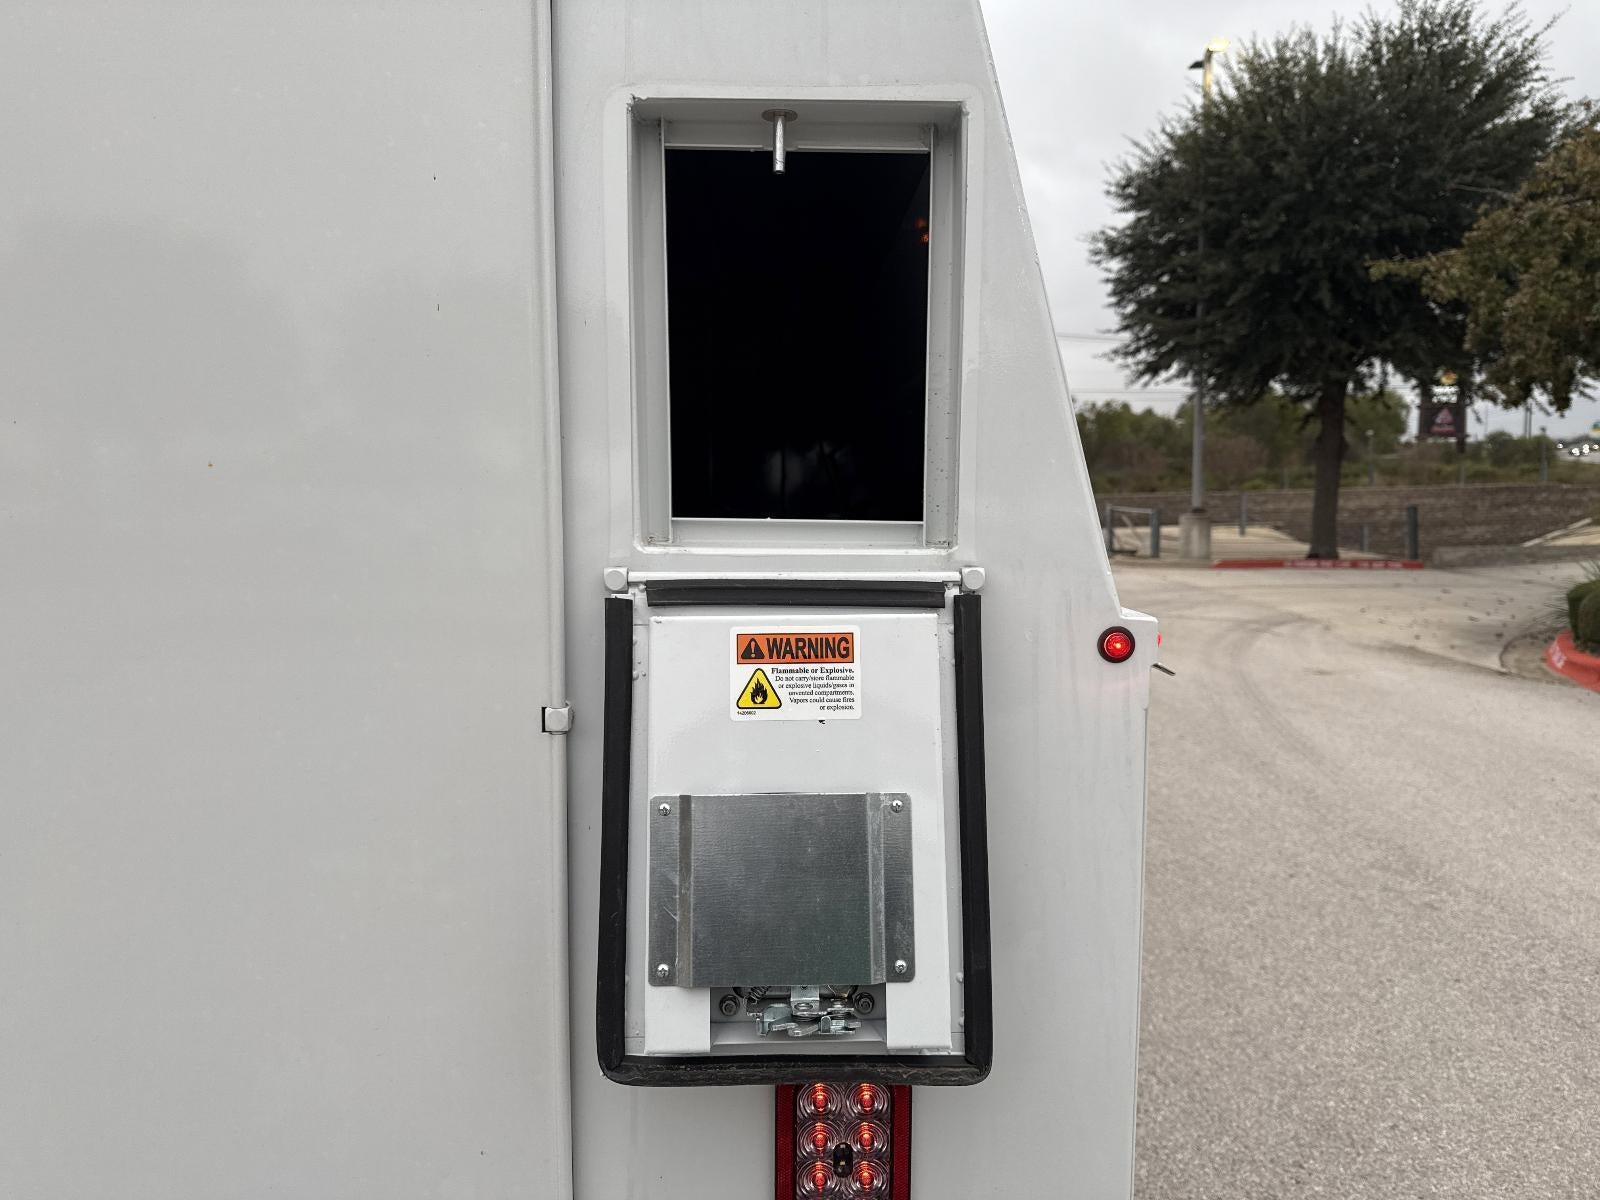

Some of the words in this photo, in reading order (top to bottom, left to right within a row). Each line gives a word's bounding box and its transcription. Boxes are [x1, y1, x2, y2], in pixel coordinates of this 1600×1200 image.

[767, 637, 850, 660] WARNING
[820, 667, 854, 675] Explosive.
[795, 675, 824, 683] carry/store
[785, 682, 811, 690] explosive
[813, 682, 848, 690] liquids/gases
[826, 704, 854, 712] explosion.
